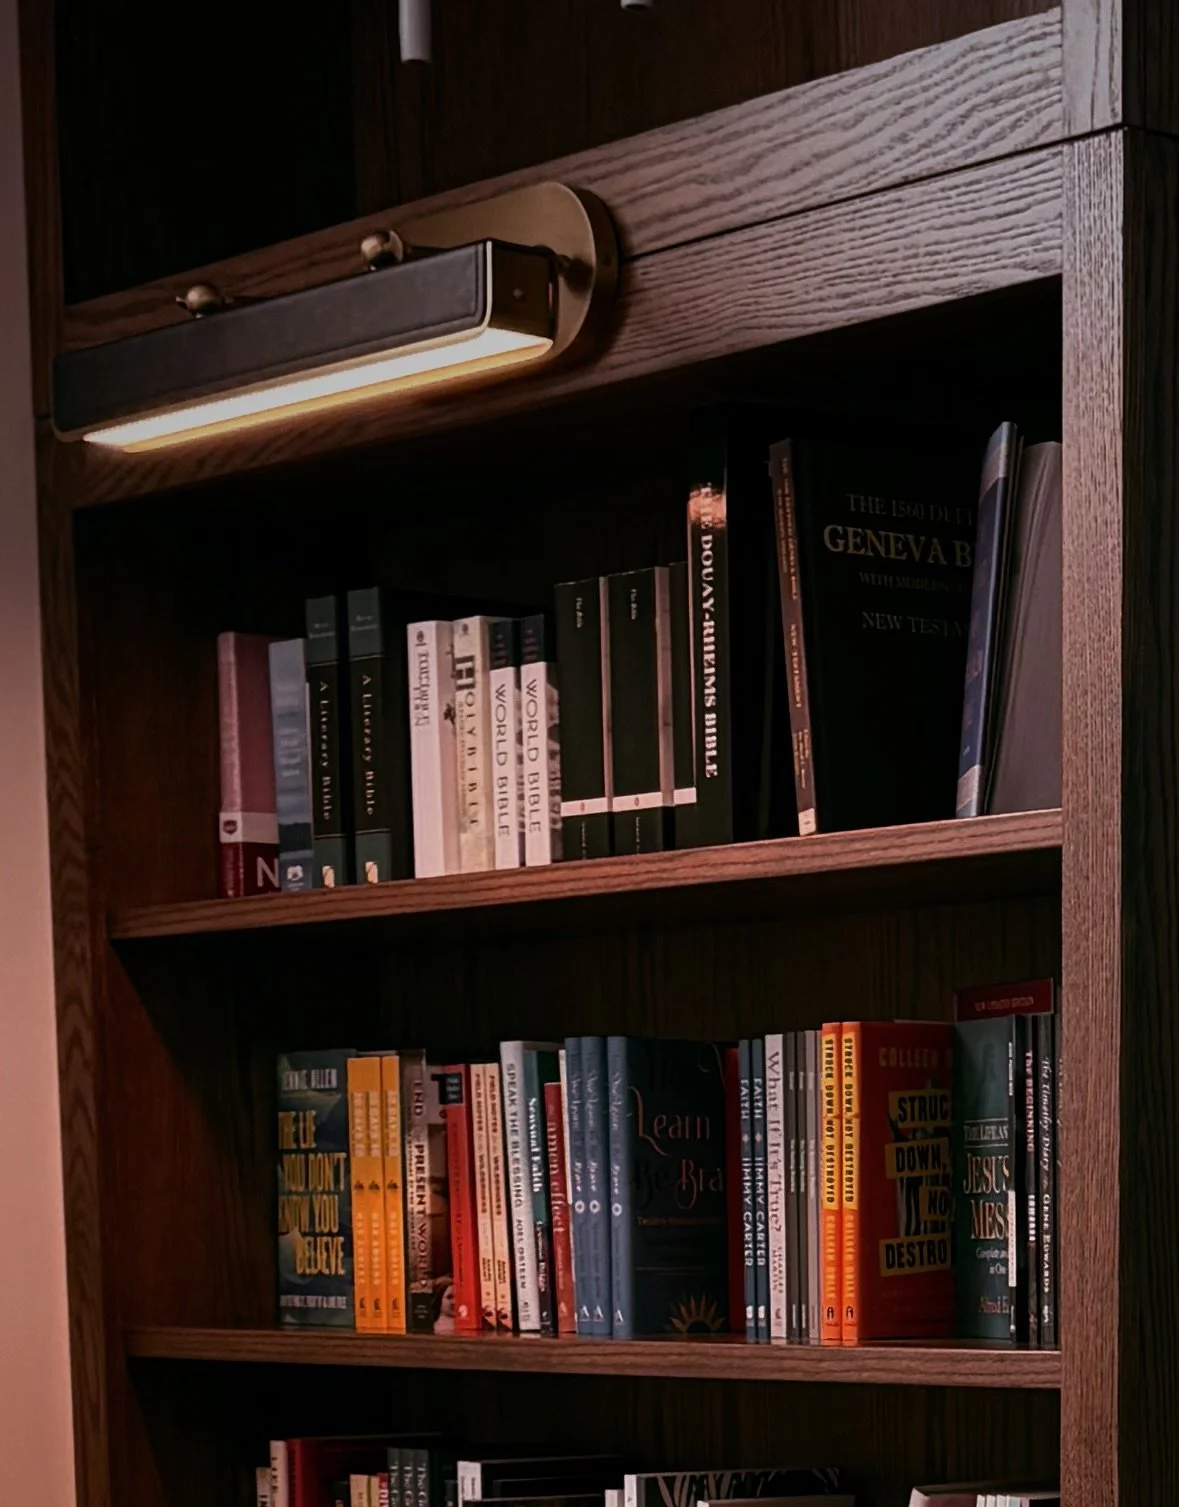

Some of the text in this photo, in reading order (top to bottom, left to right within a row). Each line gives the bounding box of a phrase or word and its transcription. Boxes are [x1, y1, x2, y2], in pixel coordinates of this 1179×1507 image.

[845, 493, 888, 516] THE
[823, 523, 948, 566] GENEVA
[700, 535, 718, 708] DOUAY-RHEIMS
[861, 610, 904, 631] NEW
[318, 681, 332, 820] A Literary Bible
[361, 674, 376, 816] A Literary Bible
[495, 683, 510, 837] WORLD BIBLE
[526, 678, 541, 835] WORLD BIBLE
[702, 712, 719, 778] BIBLE
[310, 1068, 337, 1089] ALLEN
[505, 1061, 517, 1103] SPEAK
[1024, 1049, 1036, 1153] The BEGINNING
[299, 1109, 317, 1149] LIE
[508, 1108, 518, 1136] THE
[628, 1084, 711, 1157] Learn
[825, 1038, 835, 1203] STRUCK NOT DESTROYED
[844, 1037, 855, 1203] STRUCK NOT DESTROYED
[898, 1094, 951, 1123] STRUC
[526, 1096, 542, 1192] Sensual Faith
[546, 1119, 560, 1171] amen
[767, 1050, 782, 1233] What If It's True?
[896, 1145, 947, 1173] DOWN,
[282, 1152, 347, 1192] YOU DON'T
[414, 1144, 426, 1216] PRESENT
[493, 1156, 501, 1216] WILDERNESS
[509, 1139, 522, 1207] BLESSING
[673, 1157, 724, 1210] Bra
[740, 1077, 753, 1268] FAITH JIMMY CARTER
[752, 1077, 766, 1267] FAITH JIMMY CARTER
[963, 1152, 1010, 1195] JESUS
[1040, 1056, 1052, 1293] The Timothy Diary GENE EDWARDS
[312, 1193, 340, 1234] YOU
[548, 1180, 565, 1234] effect
[295, 1235, 346, 1276] BELIEVE
[416, 1221, 427, 1289] WORLD
[518, 1246, 526, 1289] OSTEEN
[885, 1235, 949, 1270] DESTRO
[389, 1461, 400, 1486] The
[403, 1463, 414, 1488] The
[416, 1463, 428, 1488] The
